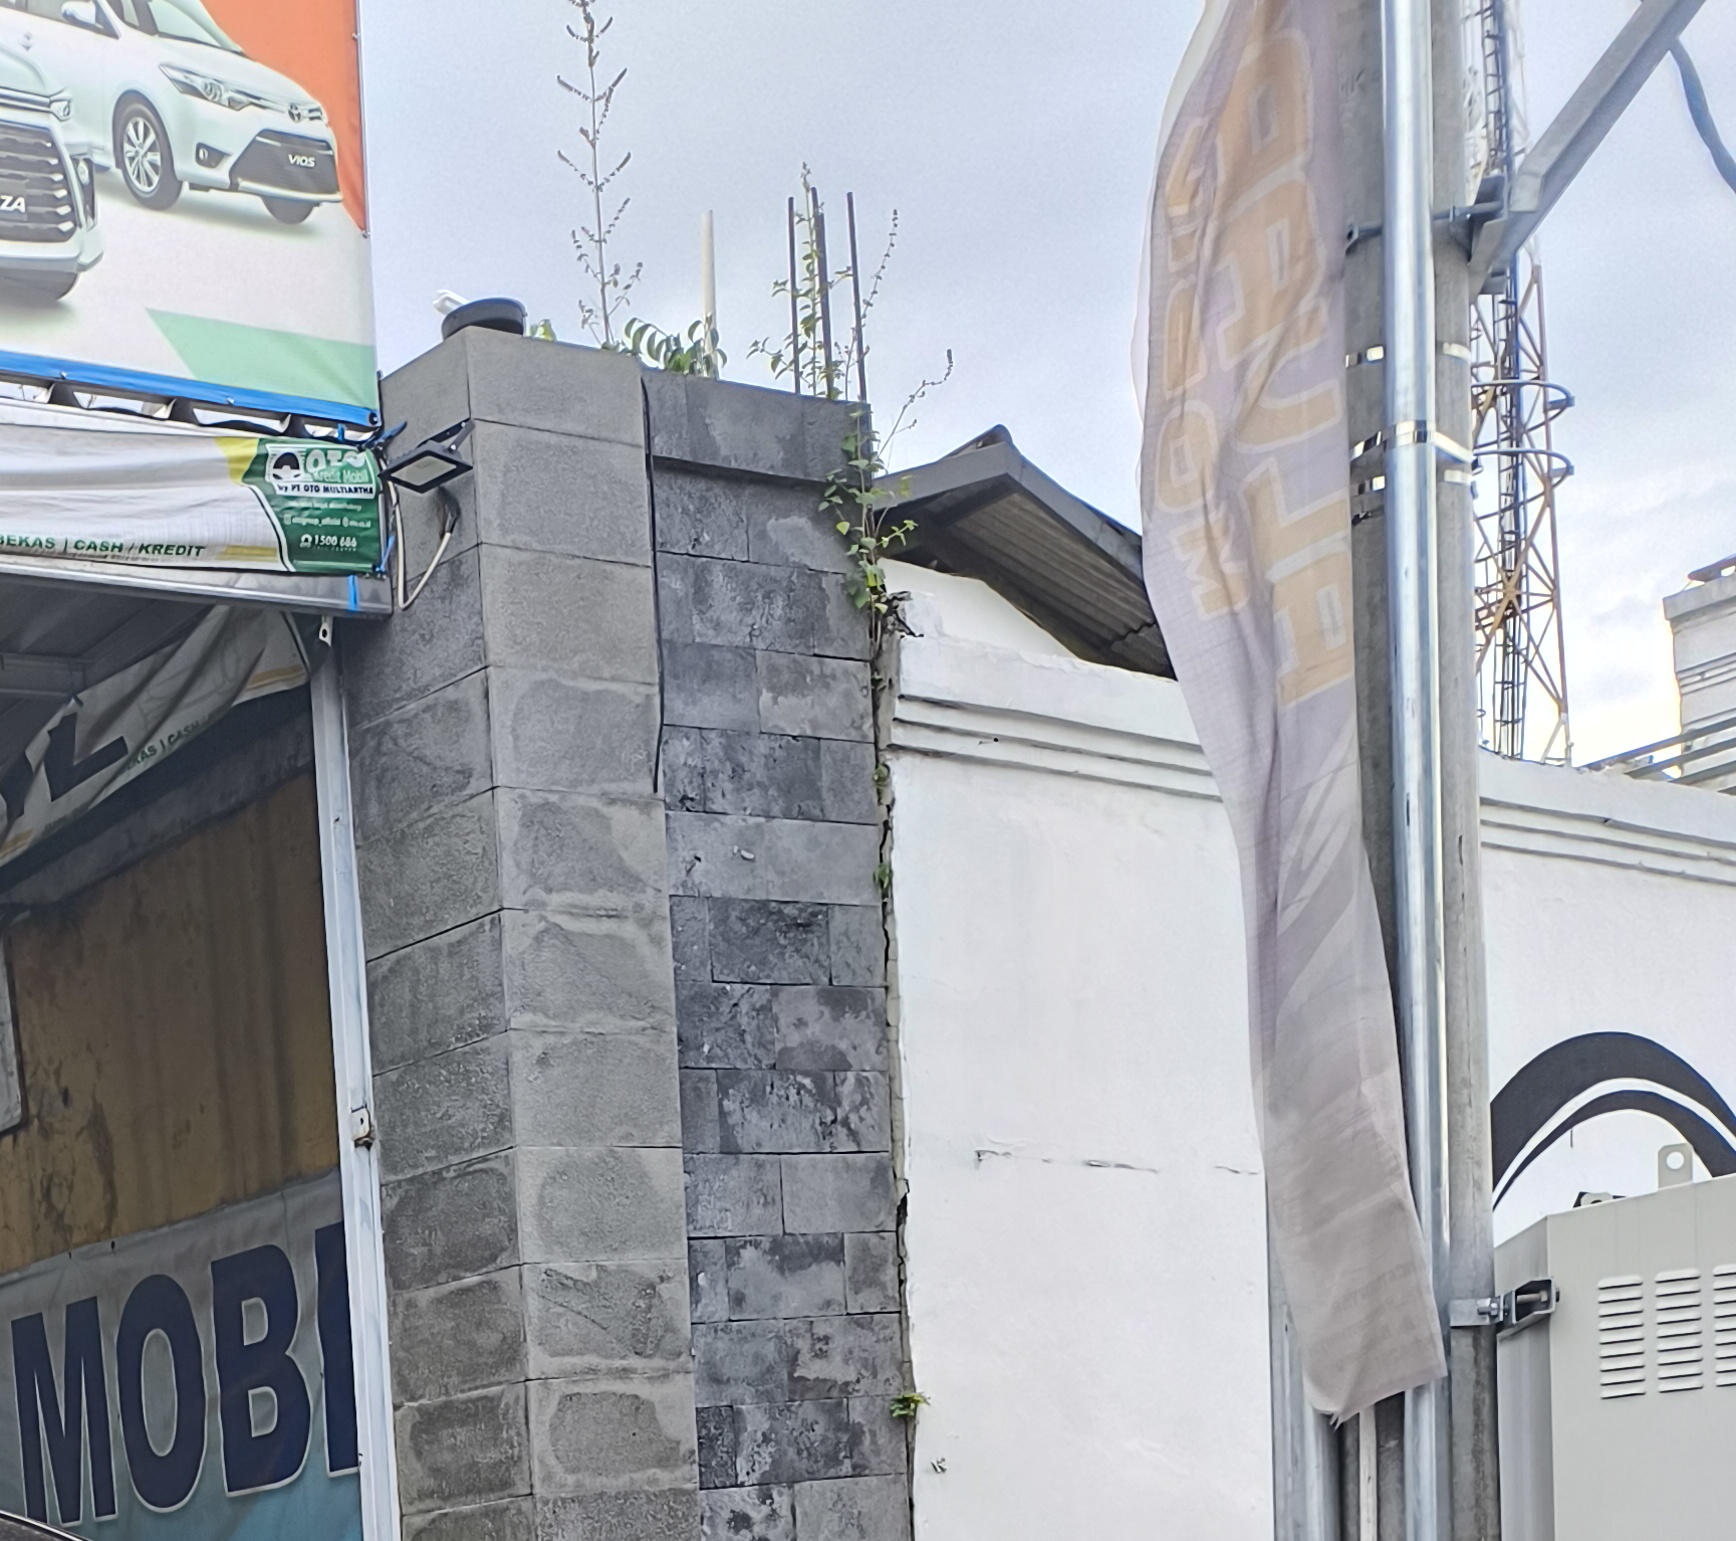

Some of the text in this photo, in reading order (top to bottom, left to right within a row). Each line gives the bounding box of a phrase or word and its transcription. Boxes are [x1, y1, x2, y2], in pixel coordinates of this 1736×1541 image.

[288, 153, 315, 168] VIOS
[303, 484, 320, 493] OTO
[314, 534, 357, 547] 1500 686
[73, 540, 124, 553] CASH
[138, 543, 206, 557] KREDIT
